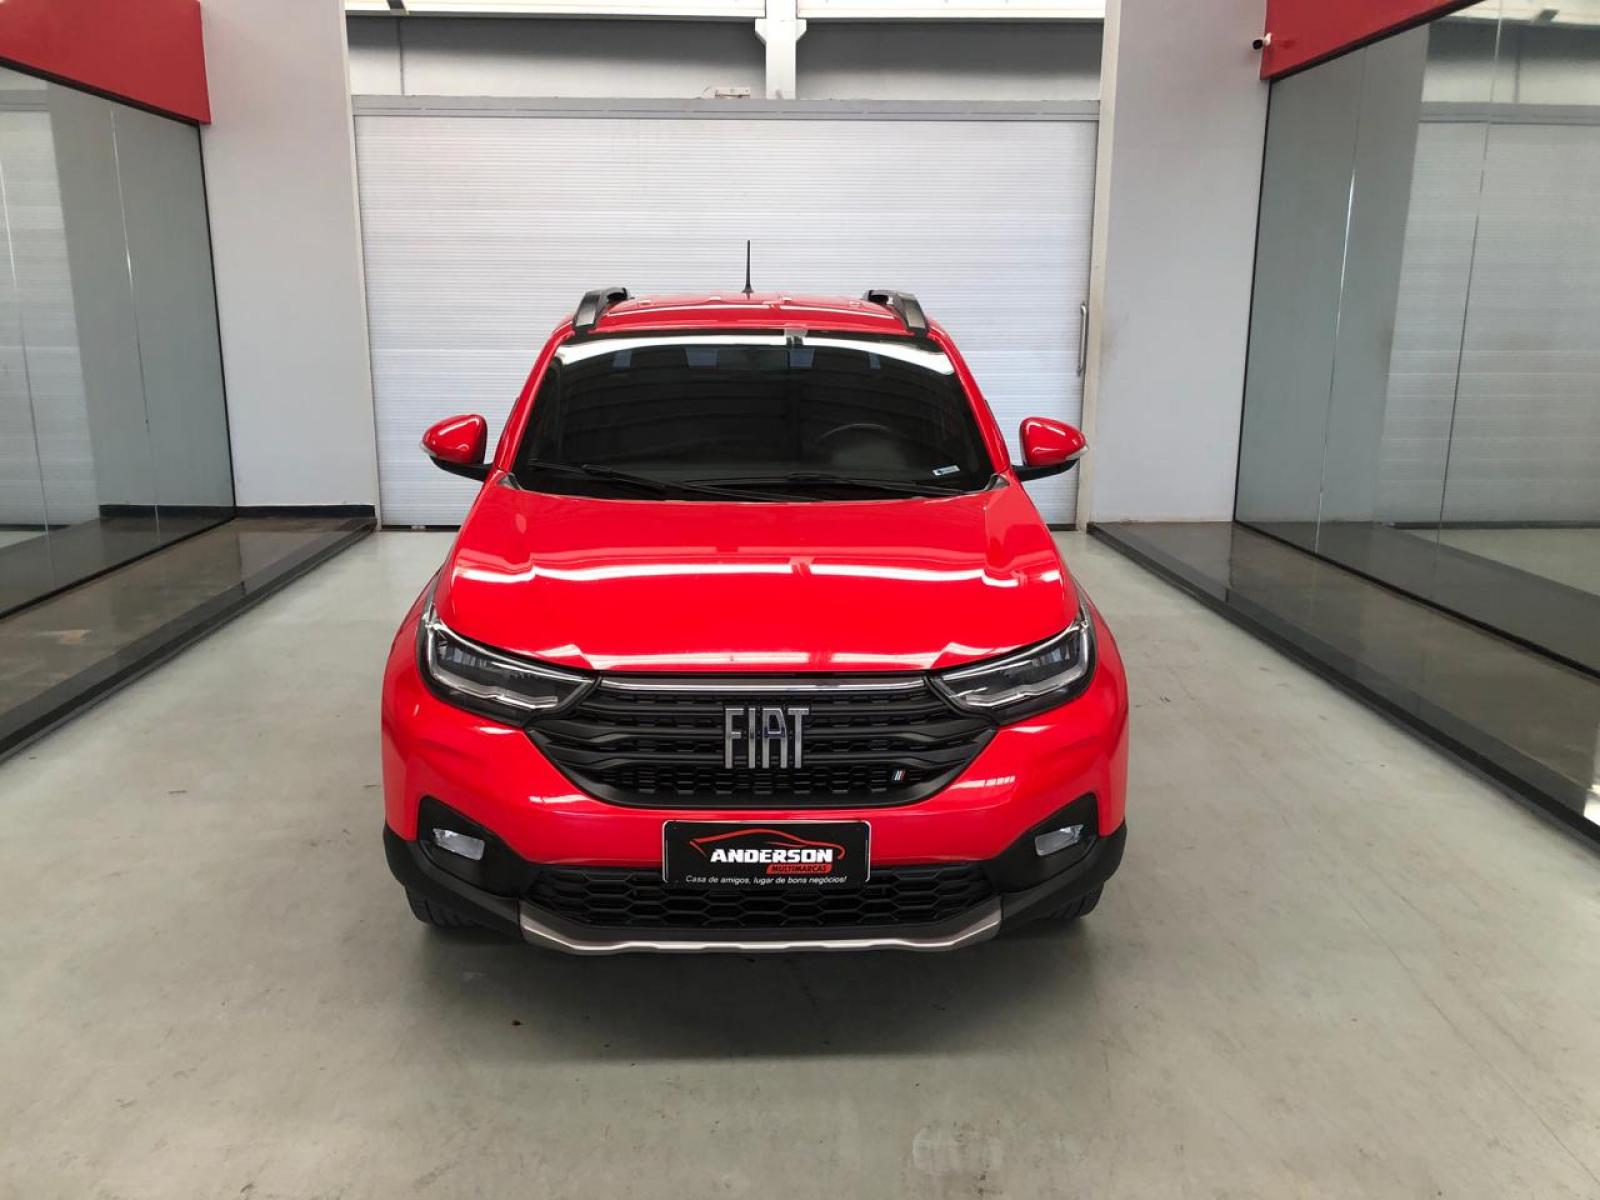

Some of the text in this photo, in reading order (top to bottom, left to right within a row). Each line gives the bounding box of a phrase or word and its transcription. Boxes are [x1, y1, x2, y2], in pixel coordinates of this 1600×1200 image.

[724, 707, 810, 770] FIAT
[710, 848, 833, 863] ANDERSON
[771, 864, 827, 873] MULTIMARCAS
[685, 874, 848, 886] Casa de amigos, lugar de bons negócios!
